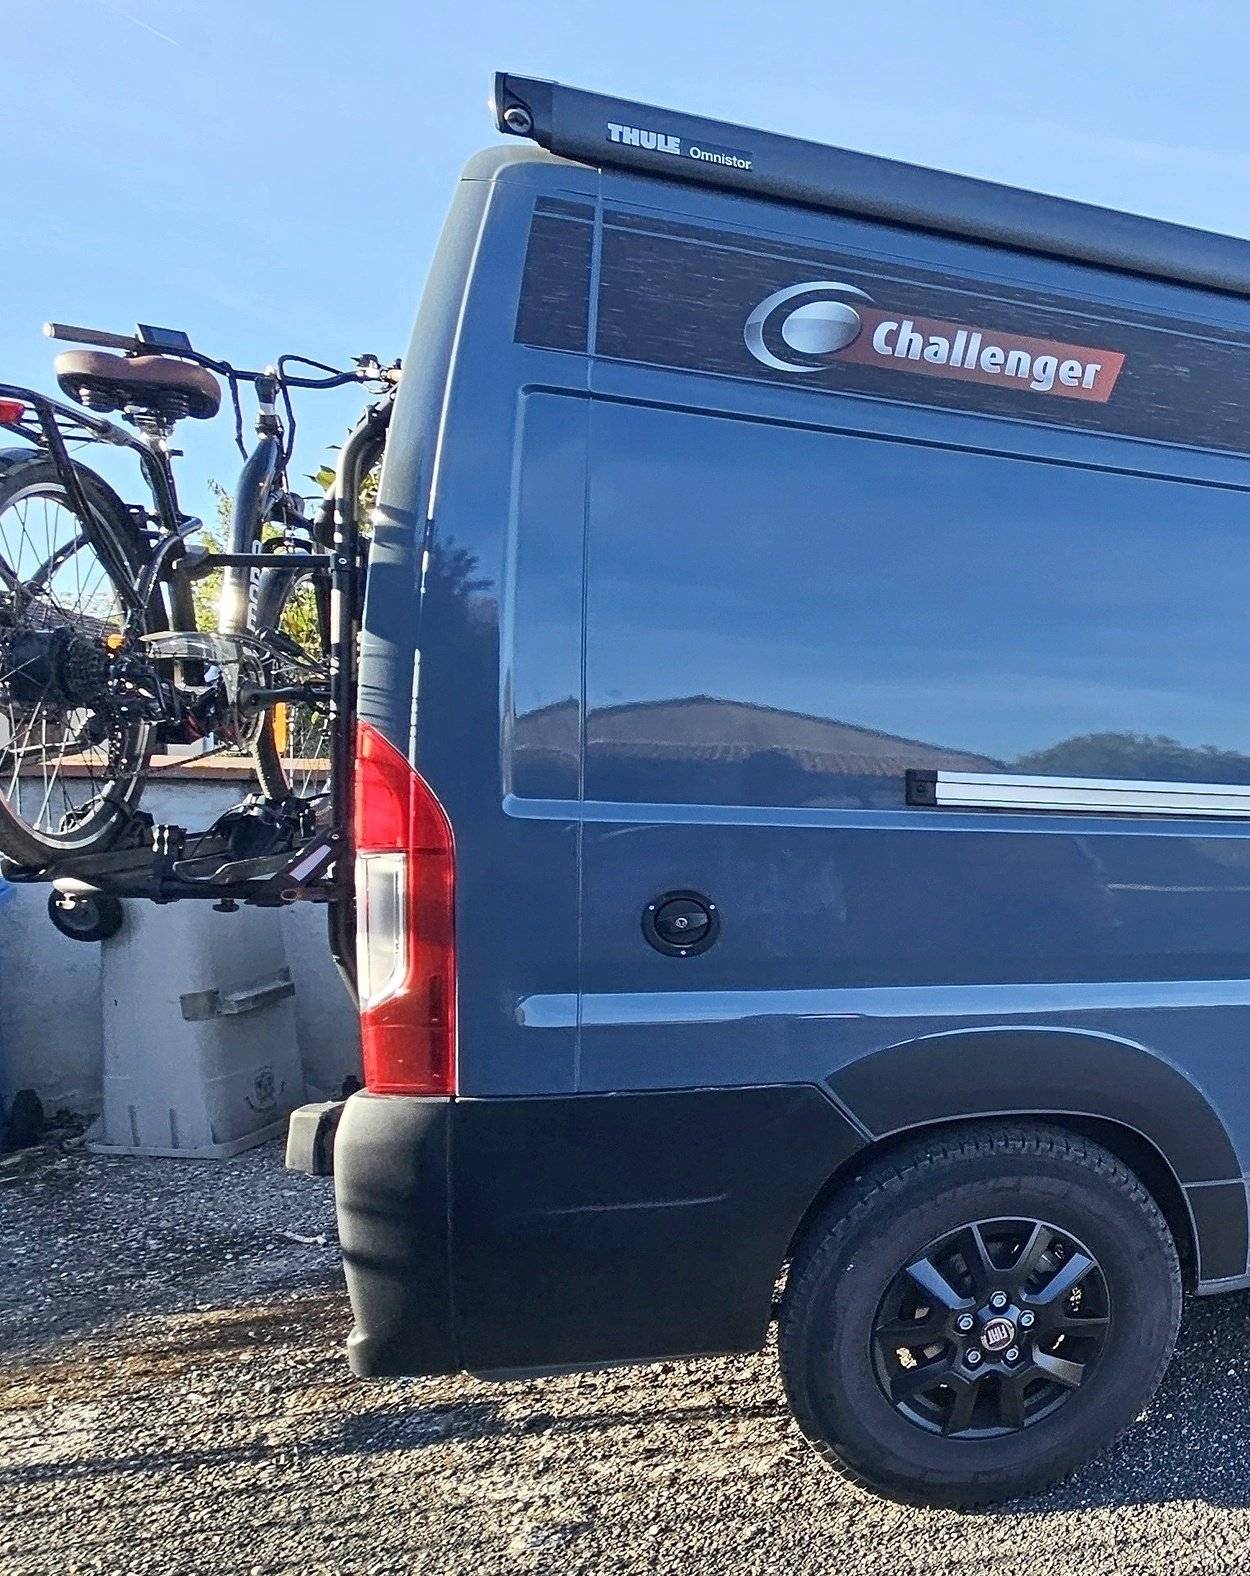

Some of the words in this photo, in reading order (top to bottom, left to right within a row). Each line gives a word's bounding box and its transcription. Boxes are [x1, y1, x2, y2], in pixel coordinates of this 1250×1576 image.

[607, 122, 681, 155] THULE
[689, 147, 753, 170] Omnistor
[872, 320, 1102, 391] Challenger
[987, 1324, 1009, 1345] FIAT
